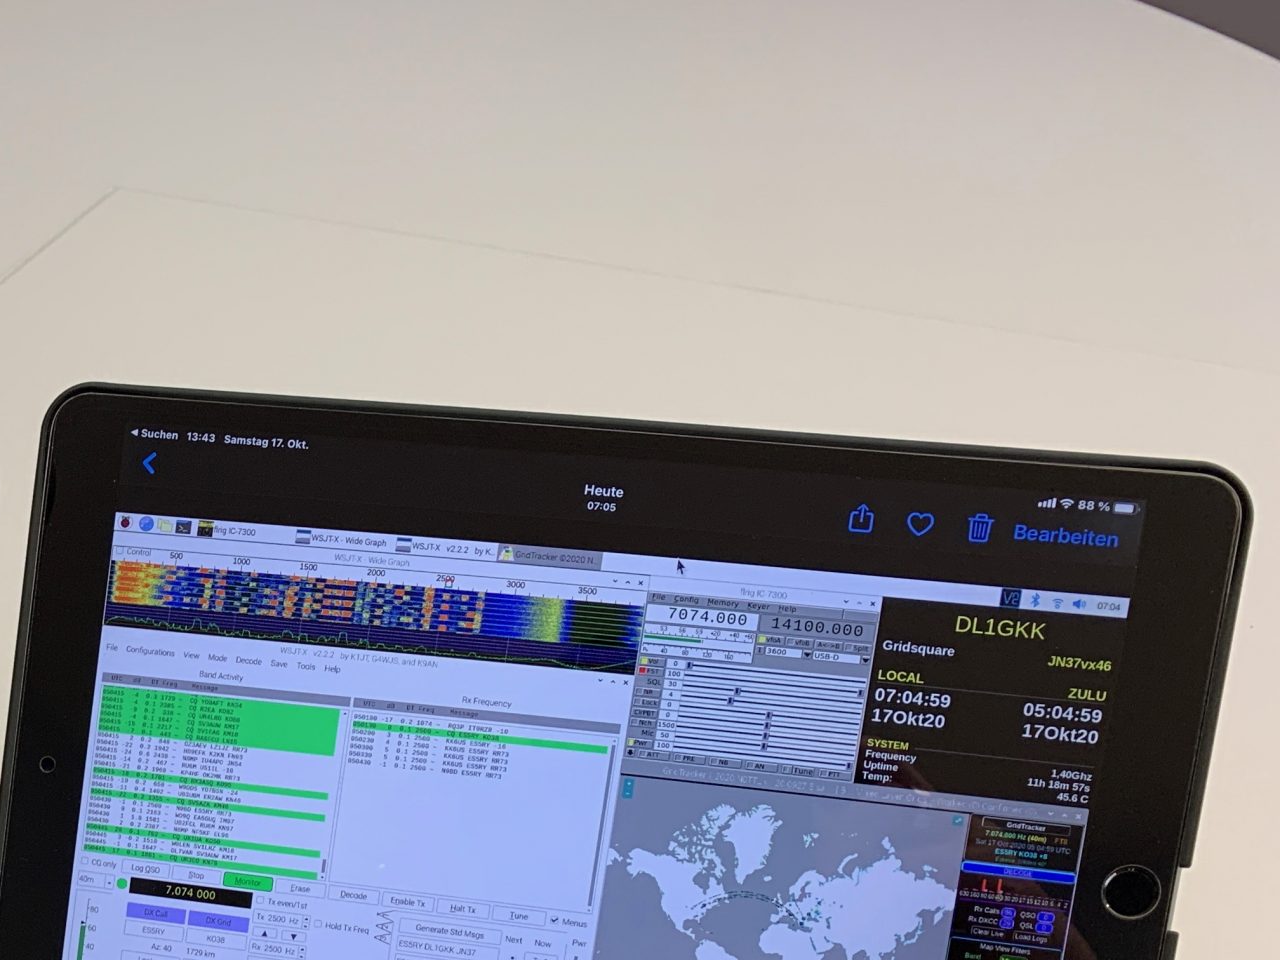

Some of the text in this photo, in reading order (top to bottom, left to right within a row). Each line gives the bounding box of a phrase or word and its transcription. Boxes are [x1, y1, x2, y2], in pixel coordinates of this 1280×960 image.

[141, 429, 309, 450] Suchen 13:43 Samstag 17. Okt.
[584, 483, 624, 499] Heute
[586, 500, 617, 513] 07:05
[1078, 500, 1110, 512] 88 %
[1013, 523, 1119, 548] Bearbeiten
[1097, 601, 1121, 612] 07:04
[669, 607, 864, 637] 7074.000 14100.000
[955, 615, 1047, 641] DL1GKK
[126, 645, 341, 674] Configurations View Mode Decode Save Tools Help
[882, 640, 1112, 672] Gridsquare JN37vx46
[878, 670, 925, 684] LOCAL
[874, 688, 1103, 725] 07:04:59 05:04:59
[1068, 688, 1107, 702] ZULU
[871, 708, 1100, 745] 17Okt20 17Okt20
[867, 738, 909, 752] SYSTEM
[863, 760, 1090, 792] Uptime 11h 18m 57s
[865, 749, 1093, 782] Frequency 1,40Ghz
[861, 771, 1089, 803] Temp: 45.6 C
